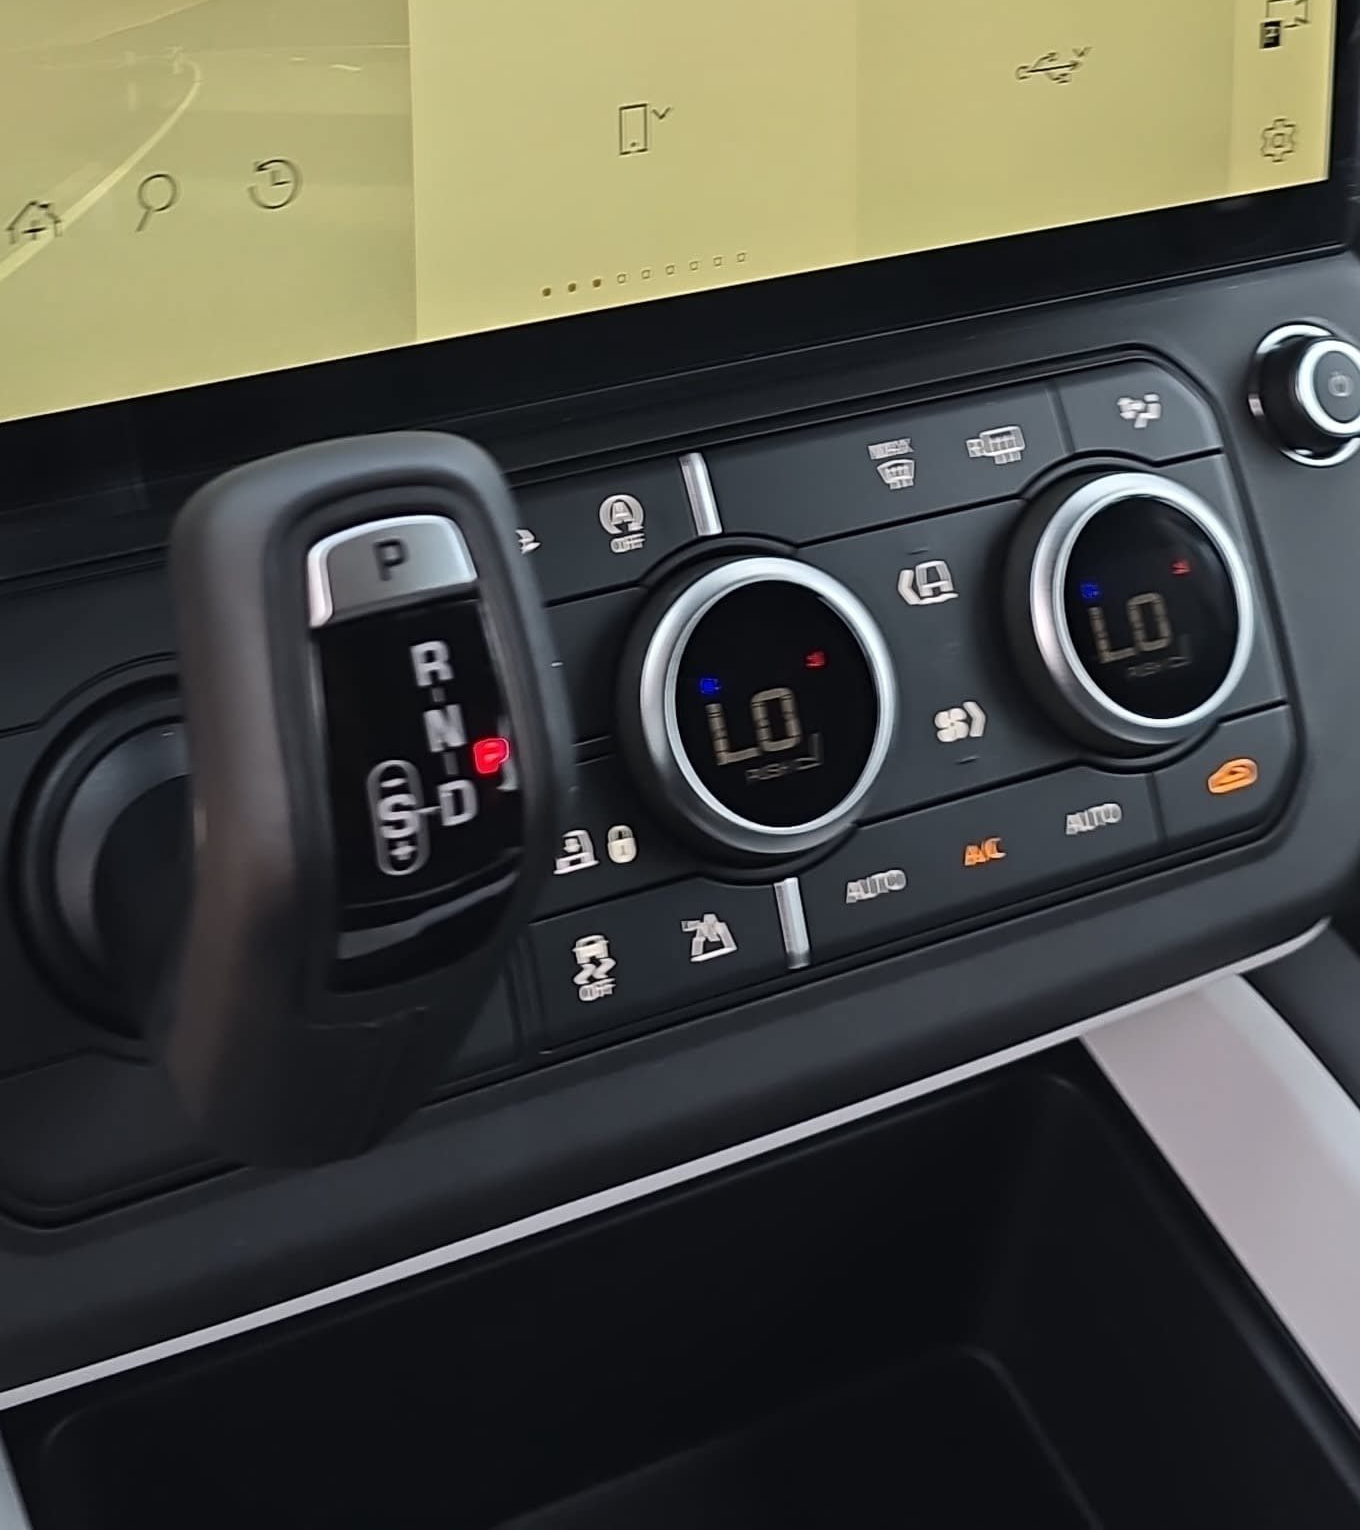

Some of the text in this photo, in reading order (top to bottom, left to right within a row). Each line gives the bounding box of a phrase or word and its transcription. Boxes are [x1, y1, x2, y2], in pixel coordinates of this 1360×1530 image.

[373, 538, 410, 581] P
[410, 640, 454, 687] R
[422, 703, 468, 753] N
[376, 779, 479, 839] S D
